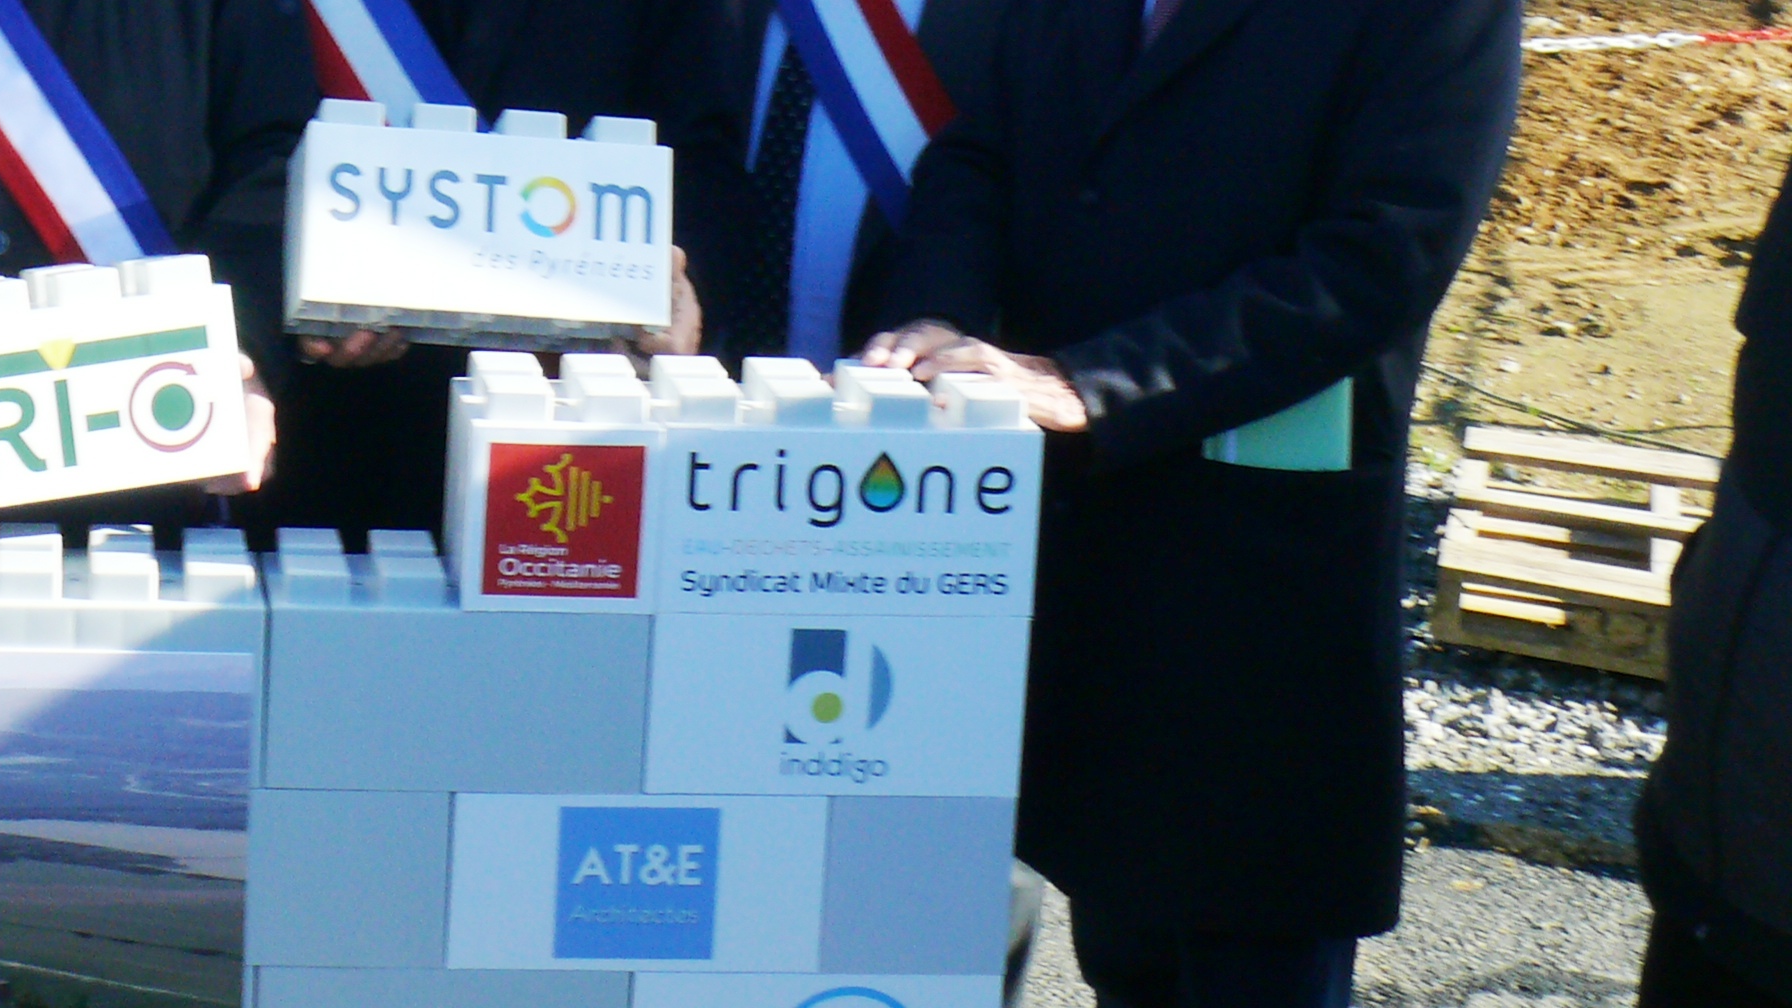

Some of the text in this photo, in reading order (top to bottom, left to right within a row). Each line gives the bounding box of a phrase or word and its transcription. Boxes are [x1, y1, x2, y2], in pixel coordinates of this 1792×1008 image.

[472, 247, 654, 280] des Pyrénées
[688, 449, 1015, 528] trigone
[498, 557, 622, 578] Occitanie
[681, 570, 1010, 597] Syndicat Mixte du GERS
[780, 752, 889, 783] inddigo
[570, 844, 704, 885] AT&E
